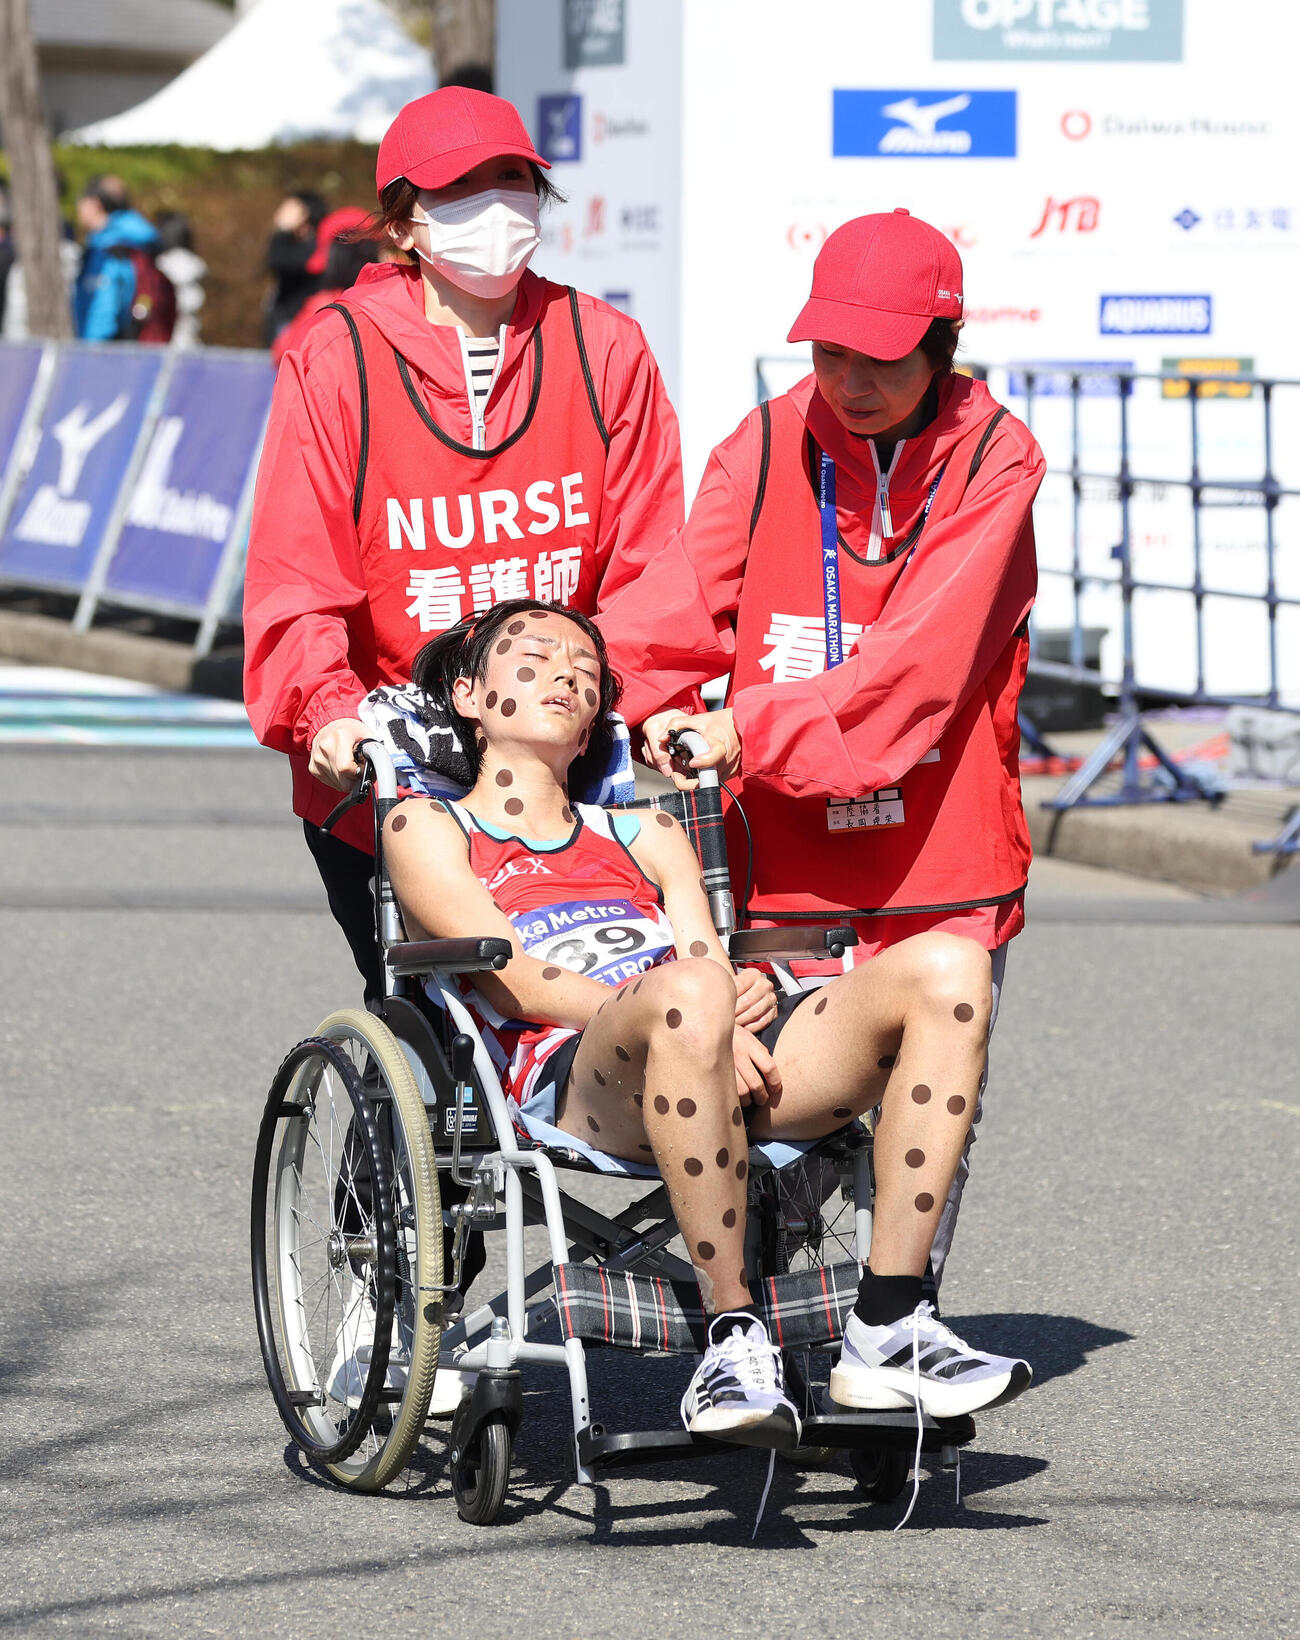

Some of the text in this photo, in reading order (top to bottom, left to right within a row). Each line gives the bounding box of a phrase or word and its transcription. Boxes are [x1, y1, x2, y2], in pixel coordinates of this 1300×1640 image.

[1030, 196, 1100, 238] JTB
[1103, 298, 1208, 333] AQUARIUS
[386, 471, 590, 551] NURSE
[405, 546, 583, 632] 看護師
[825, 566, 840, 662] OSAKA MARATHON
[547, 905, 626, 931] Metro
